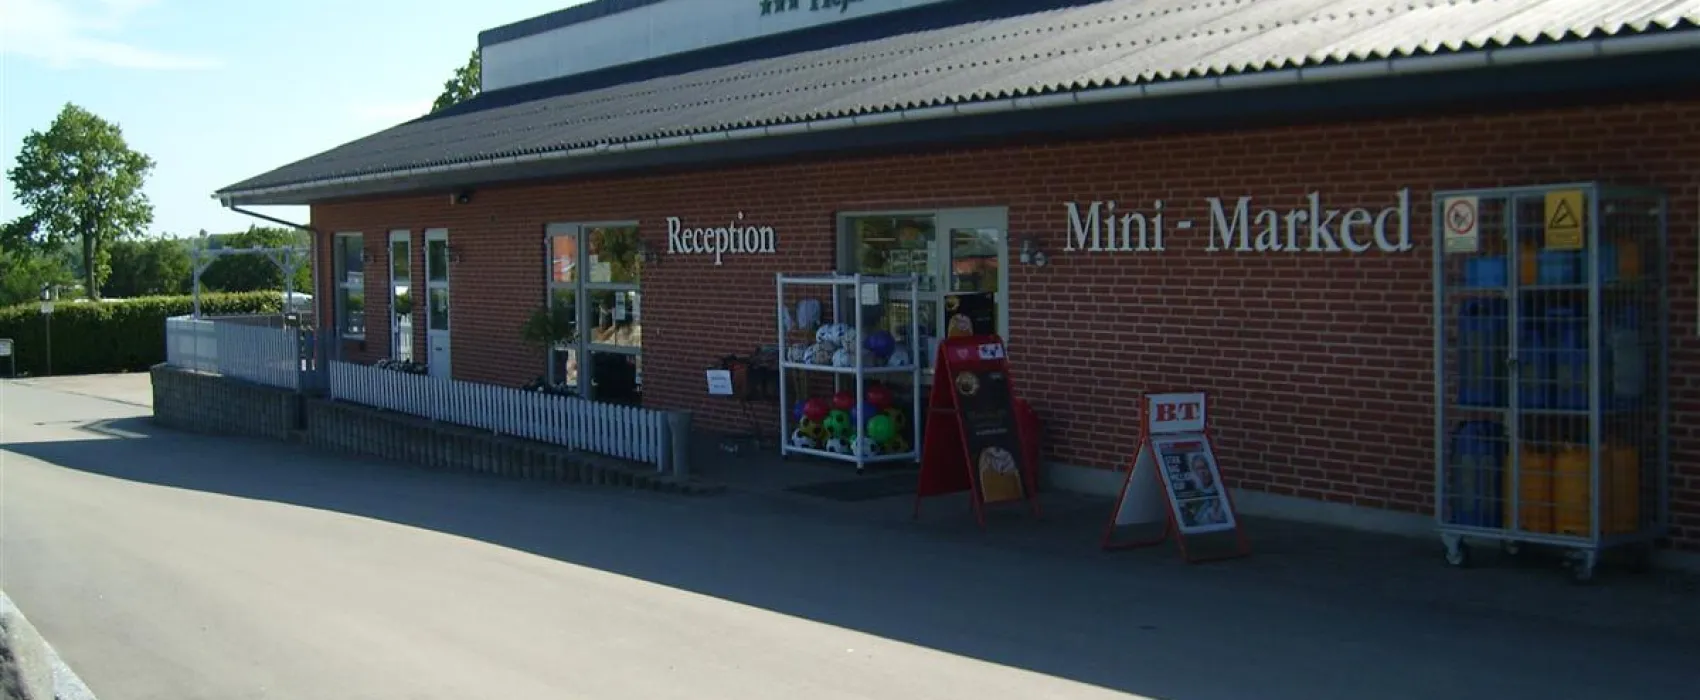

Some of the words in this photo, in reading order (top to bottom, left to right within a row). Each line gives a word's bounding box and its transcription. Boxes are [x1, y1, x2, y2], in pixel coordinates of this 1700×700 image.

[666, 211, 776, 265] Reception
[1064, 199, 1165, 252] Mini
[1205, 187, 1413, 252] Marked
